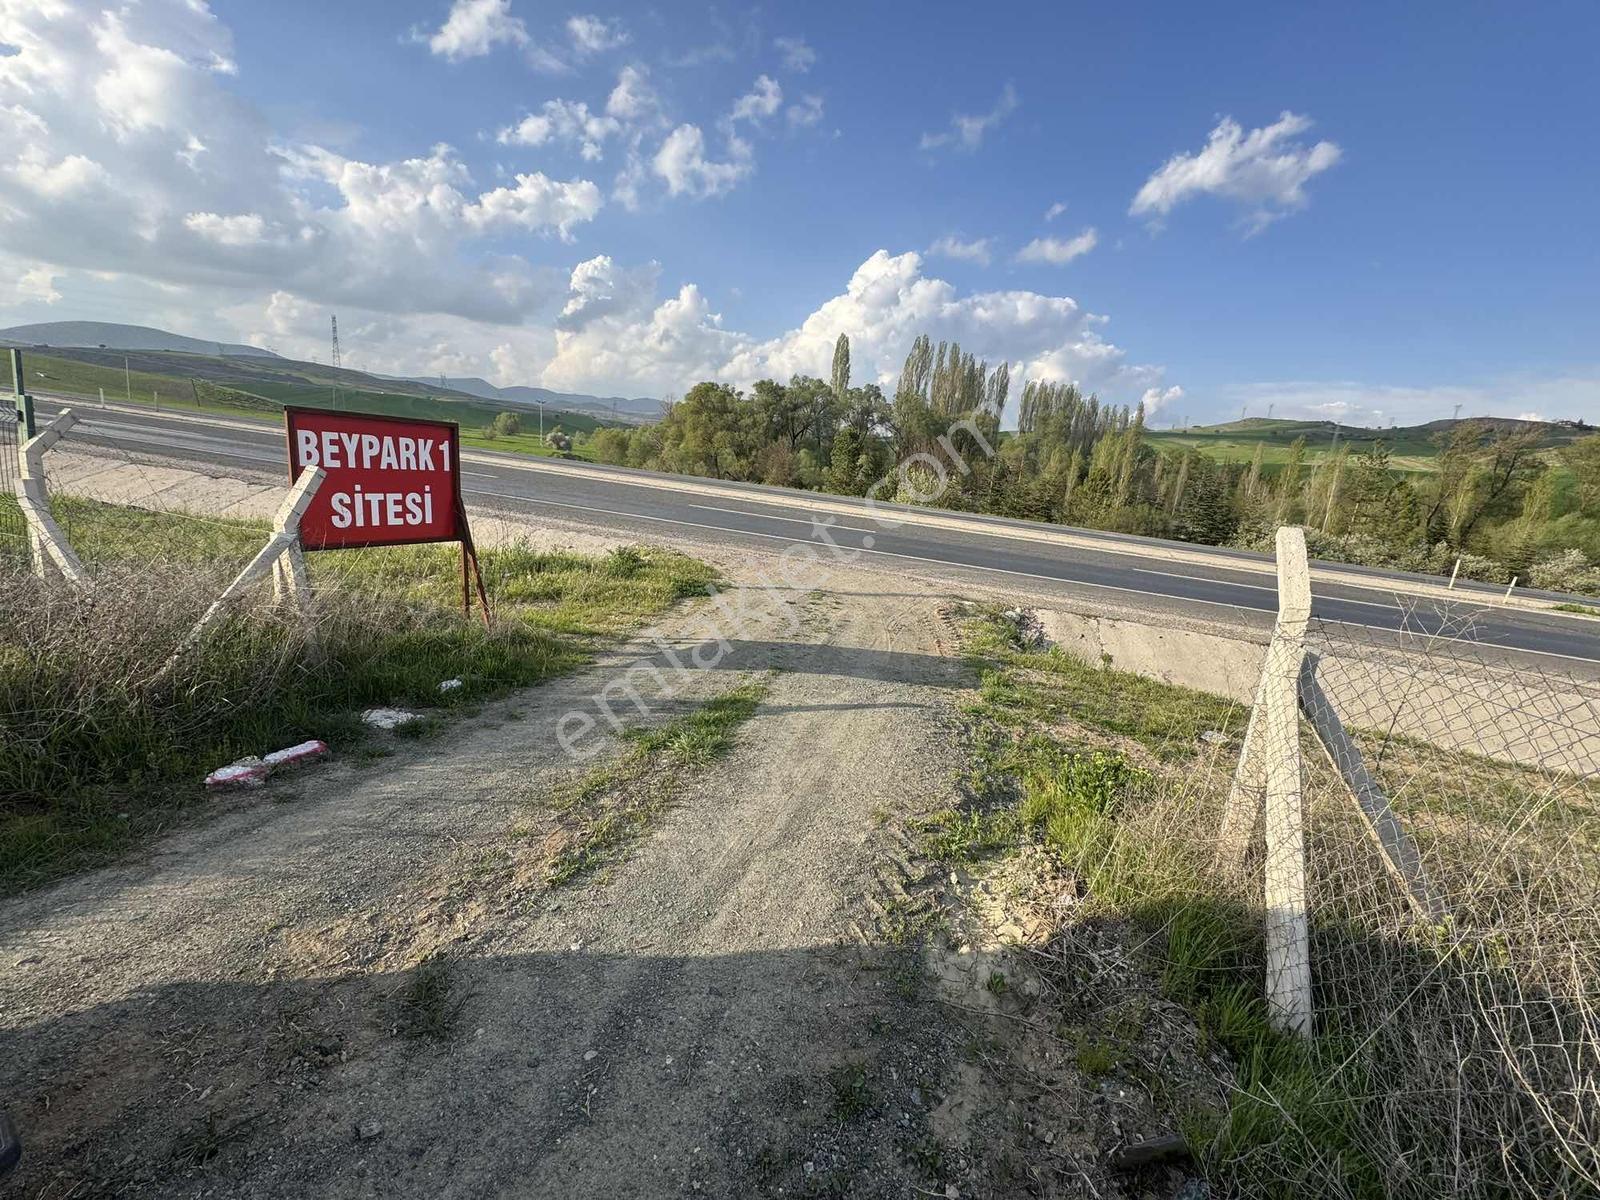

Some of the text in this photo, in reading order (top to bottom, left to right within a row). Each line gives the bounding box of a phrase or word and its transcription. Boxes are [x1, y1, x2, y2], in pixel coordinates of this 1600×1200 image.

[296, 429, 450, 472] BEYPARK 1
[331, 484, 433, 529] SİTESİ
